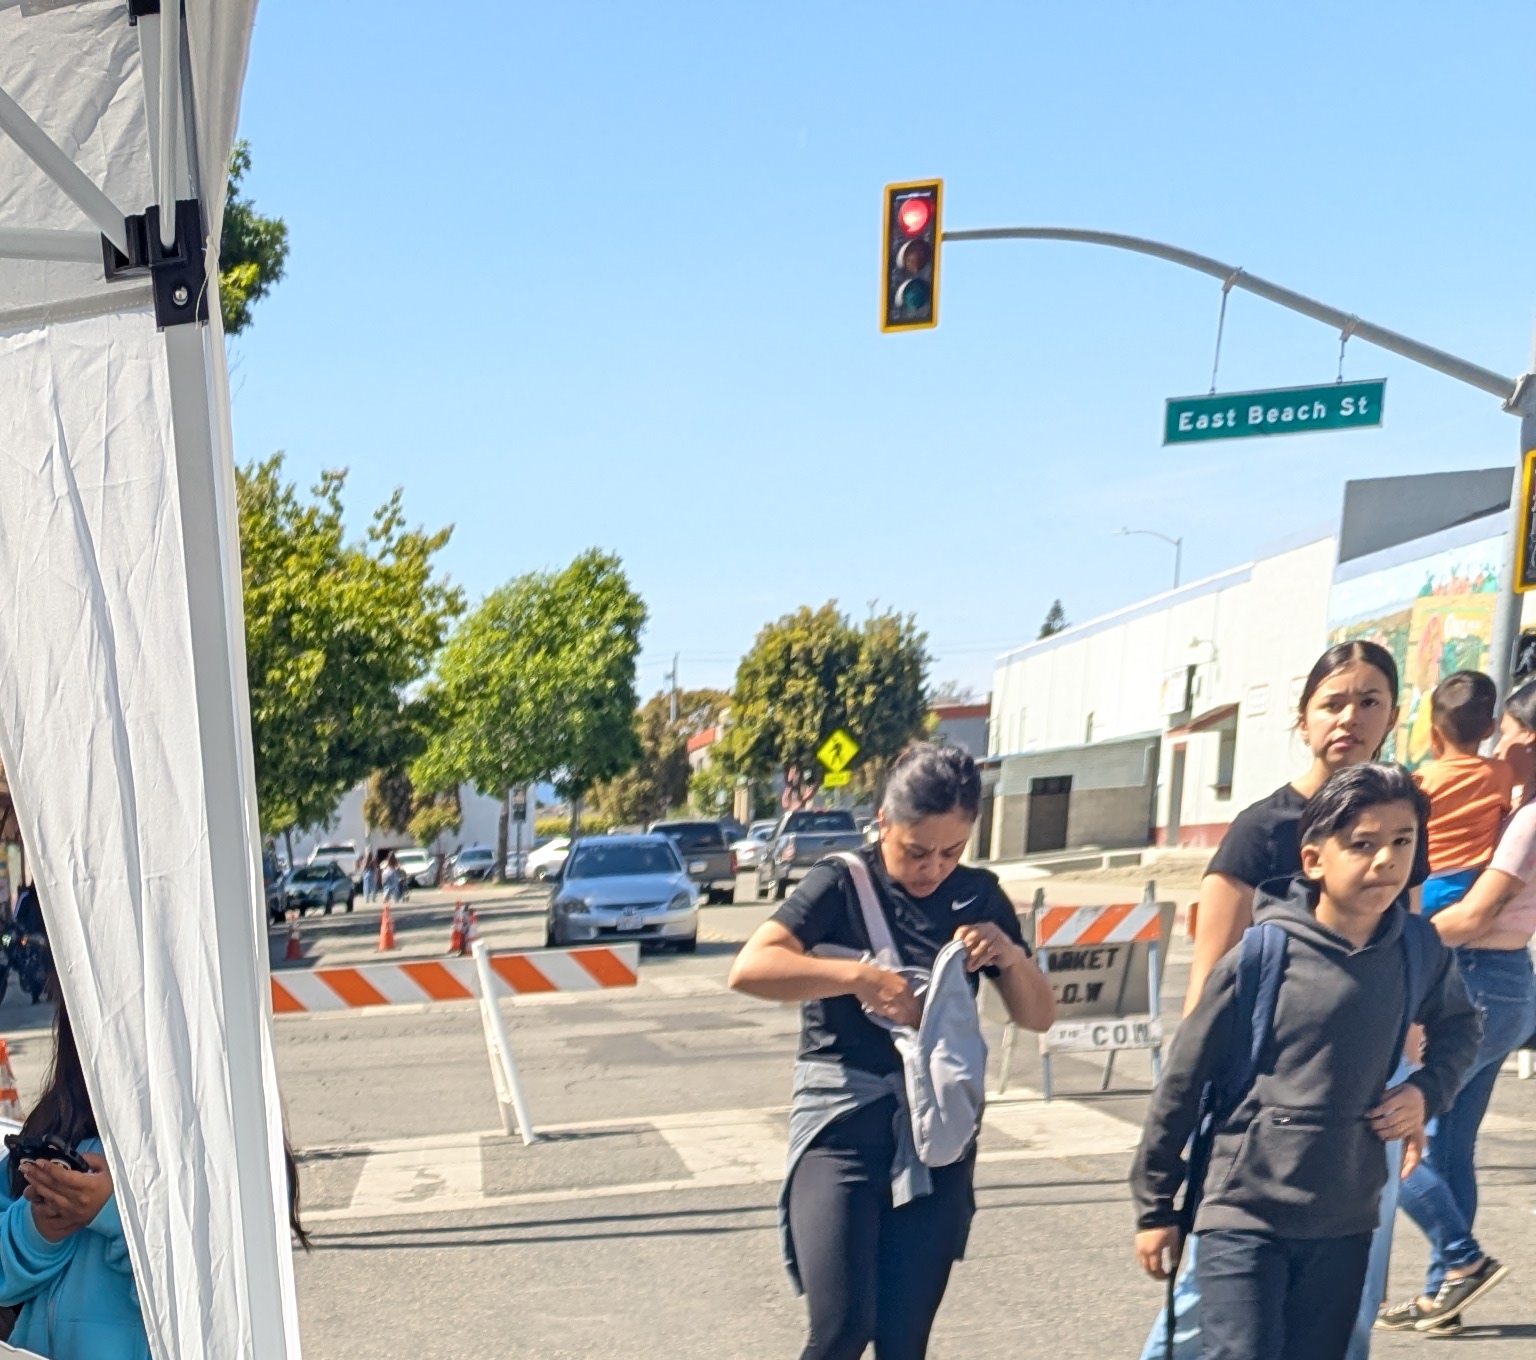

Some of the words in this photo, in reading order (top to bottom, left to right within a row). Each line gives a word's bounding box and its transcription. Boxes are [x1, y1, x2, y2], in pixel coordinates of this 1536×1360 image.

[1178, 408, 1237, 431] East
[1247, 402, 1326, 425] Beach
[1339, 396, 1368, 416] St
